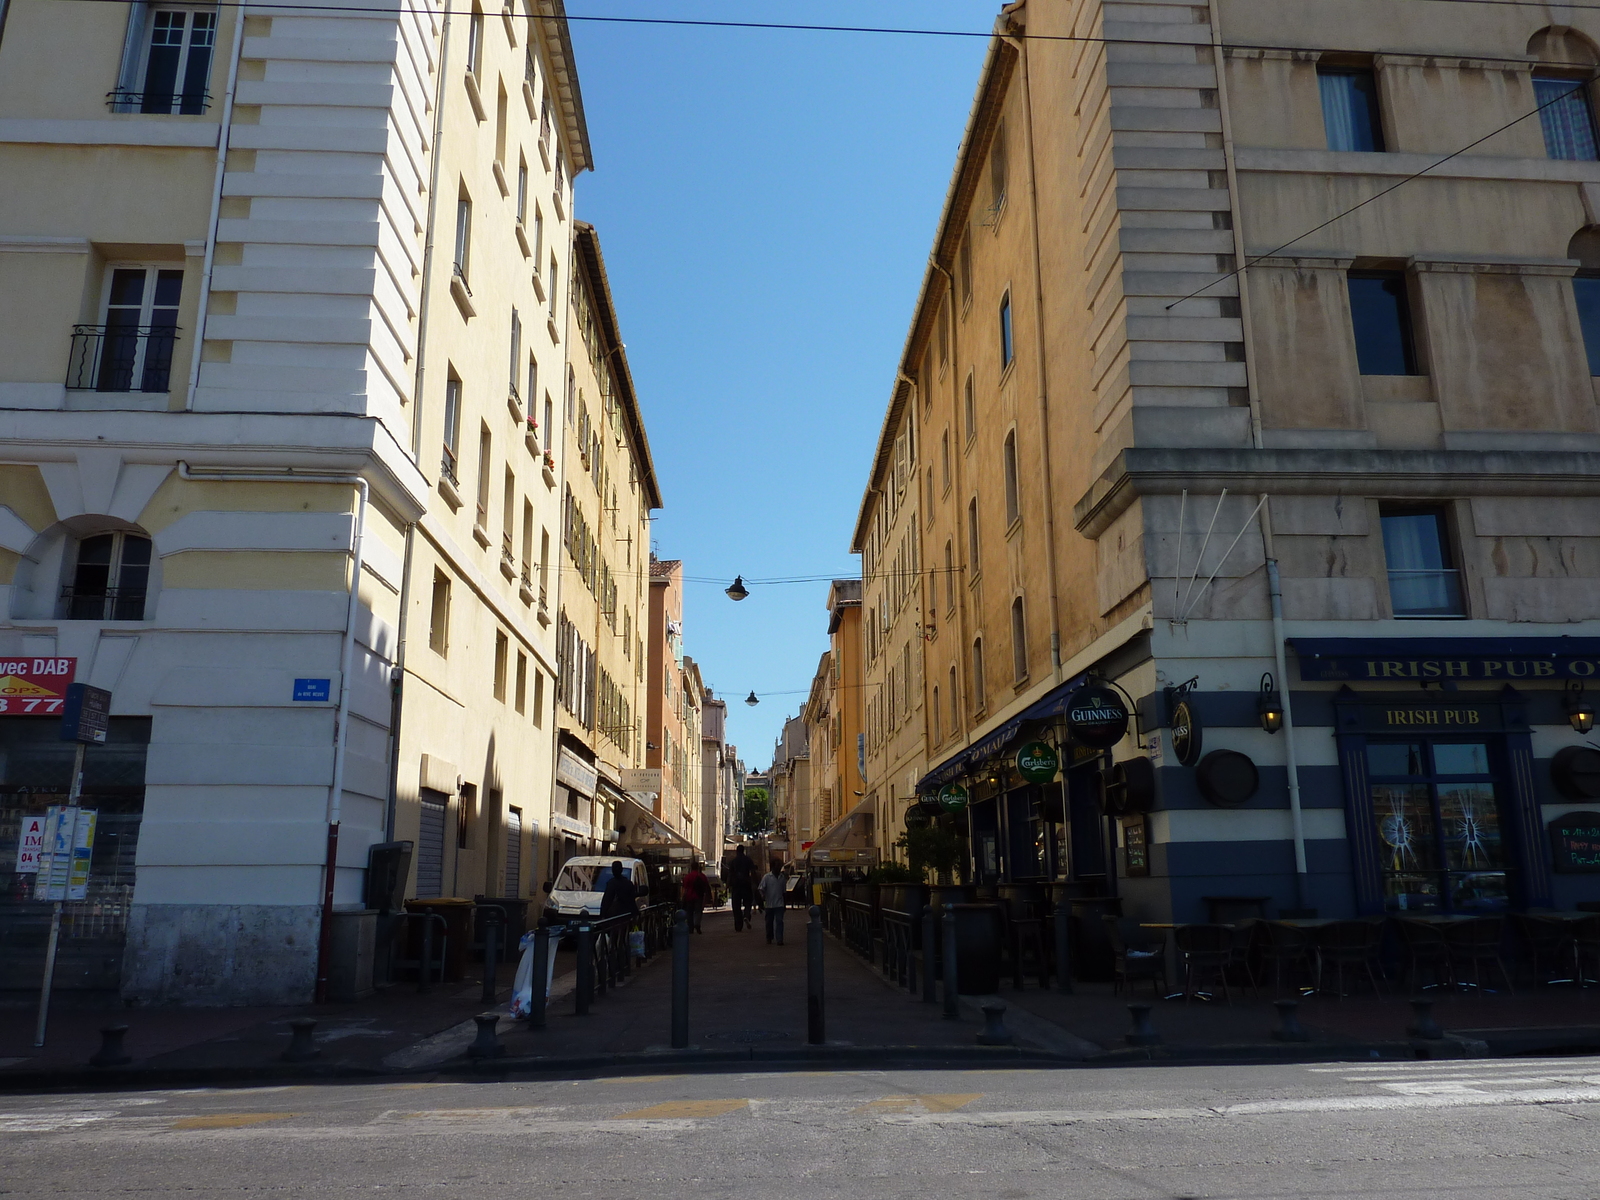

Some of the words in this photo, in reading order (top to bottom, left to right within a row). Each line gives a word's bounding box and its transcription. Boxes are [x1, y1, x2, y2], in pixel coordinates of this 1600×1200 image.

[32, 659, 70, 676] DAB
[1366, 660, 1471, 678] IRISH
[1482, 660, 1556, 678] PUB
[1071, 709, 1123, 722] GUINNESS
[1386, 709, 1439, 725] IRISH
[1443, 709, 1480, 725] PUB
[1021, 755, 1056, 771] Carlsberg
[941, 794, 966, 805] Carlsberg
[30, 821, 39, 832] A
[21, 853, 32, 862] 04
